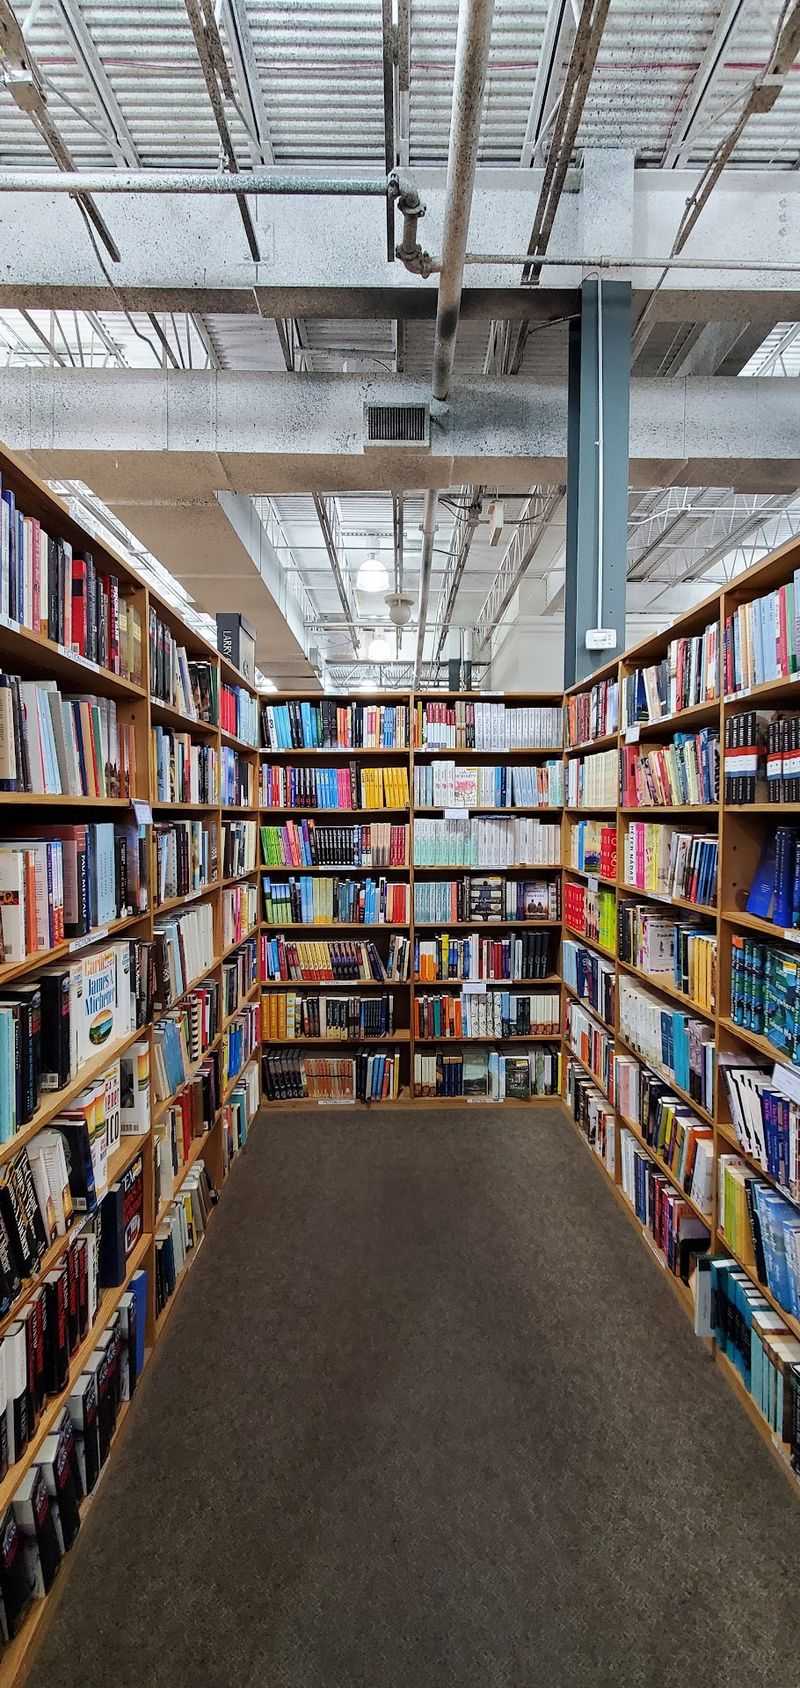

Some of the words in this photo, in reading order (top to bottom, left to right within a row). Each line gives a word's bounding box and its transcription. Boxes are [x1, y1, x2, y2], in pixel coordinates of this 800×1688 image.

[223, 630, 232, 657] LARRY
[88, 974, 110, 998] James
[106, 1111, 119, 1147] ICO
